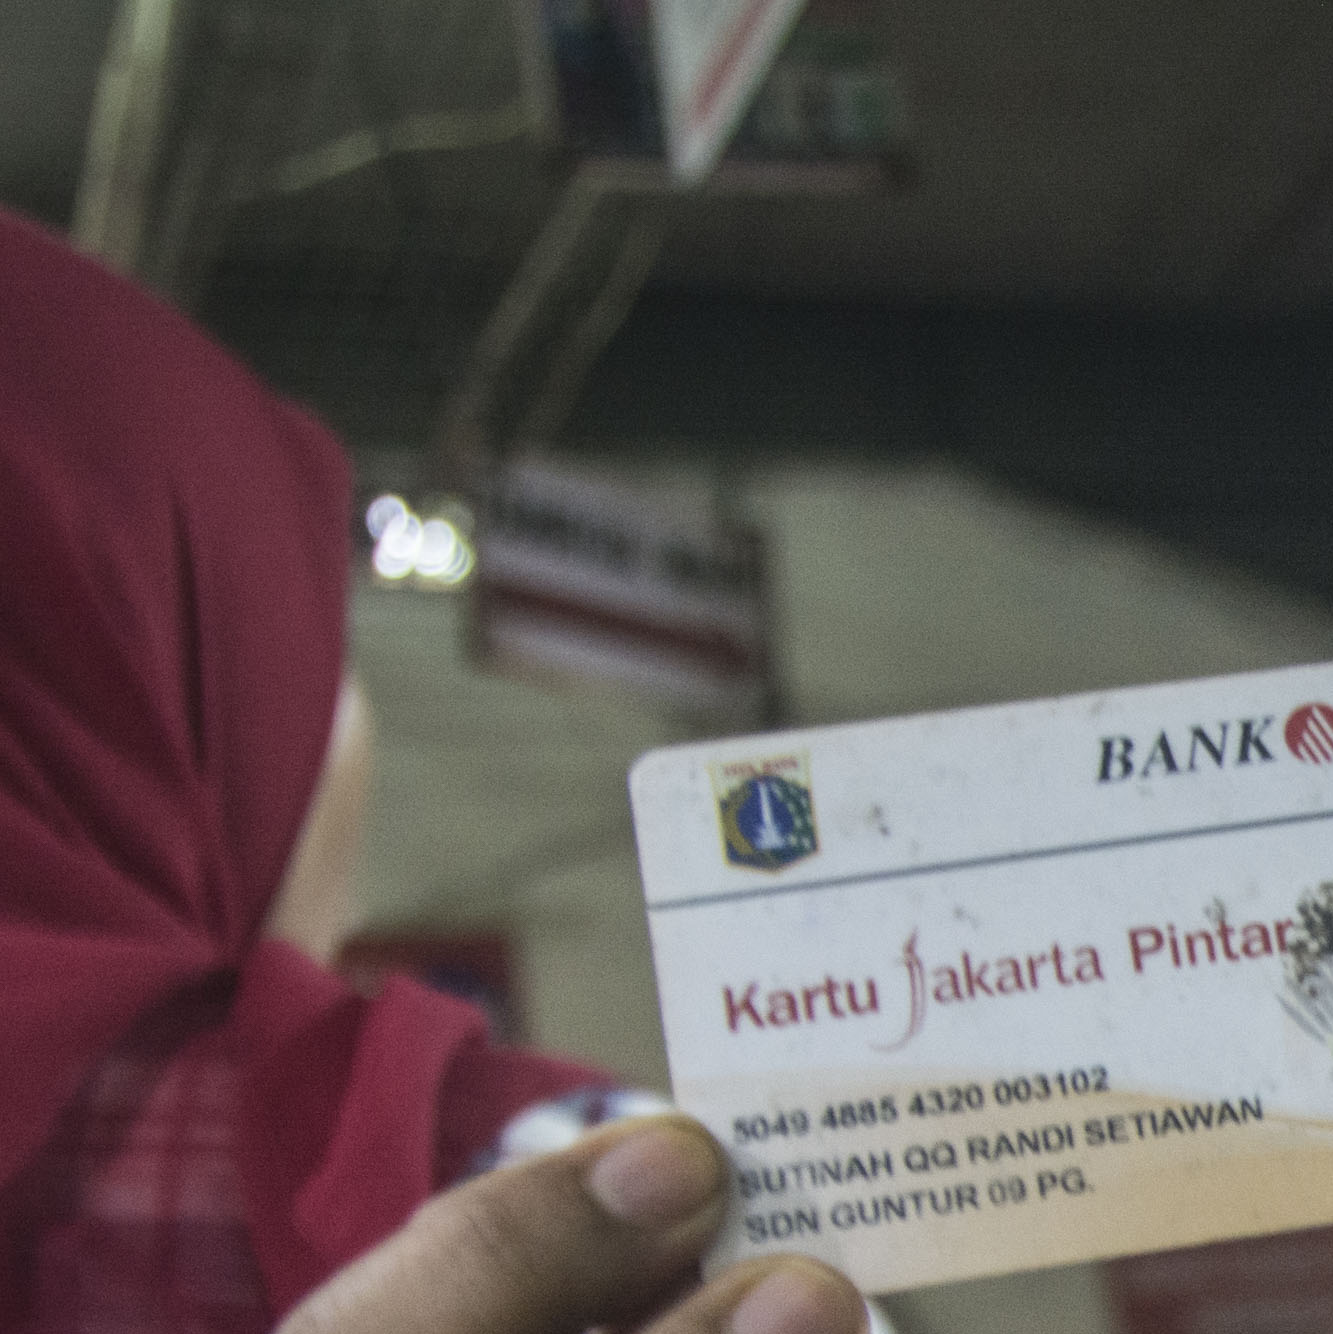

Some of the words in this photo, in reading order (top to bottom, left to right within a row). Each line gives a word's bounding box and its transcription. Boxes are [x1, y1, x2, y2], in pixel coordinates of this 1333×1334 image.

[1096, 714, 1276, 784] BANK
[722, 973, 880, 1034] Kartu
[868, 925, 1105, 1054] Jakarta
[1126, 915, 1296, 974] Pintar
[733, 1111, 811, 1146] 5049
[820, 1094, 899, 1132] 4885
[907, 1082, 984, 1118] 4320
[992, 1064, 1111, 1108] 003102
[903, 1140, 958, 1174] QQ
[966, 1118, 1076, 1162] RANDI
[1084, 1093, 1265, 1147] SETIAWAN
[743, 1210, 822, 1246] SDN
[830, 1182, 980, 1231] GUNTUR
[987, 1174, 1028, 1209] 09
[1036, 1167, 1096, 1198] PG.
